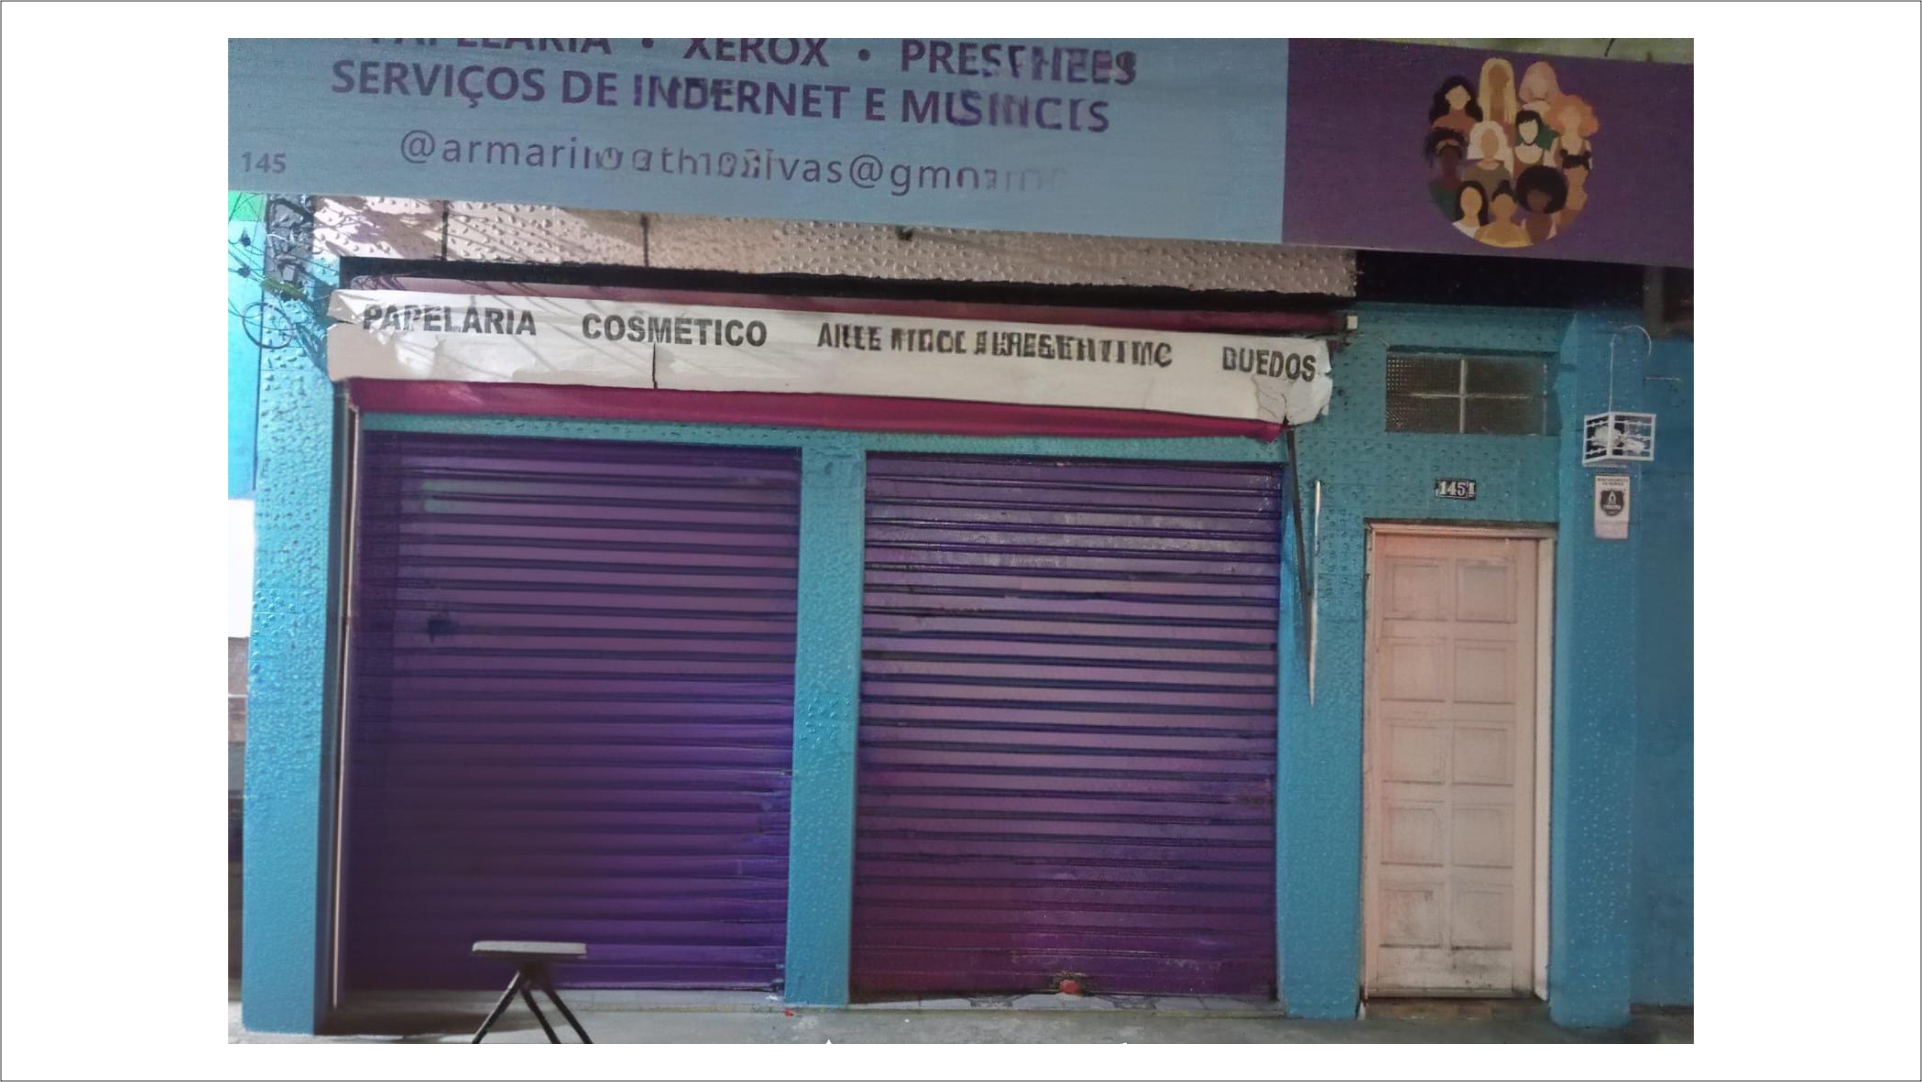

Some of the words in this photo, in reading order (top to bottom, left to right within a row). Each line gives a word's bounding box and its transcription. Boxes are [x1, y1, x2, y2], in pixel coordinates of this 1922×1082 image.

[682, 38, 830, 67] XEROX
[331, 59, 546, 109] SERVIÇOS
[562, 70, 619, 106] DE
[865, 87, 886, 121] E
[241, 151, 286, 174] 145
[582, 313, 767, 347] COSMETICO
